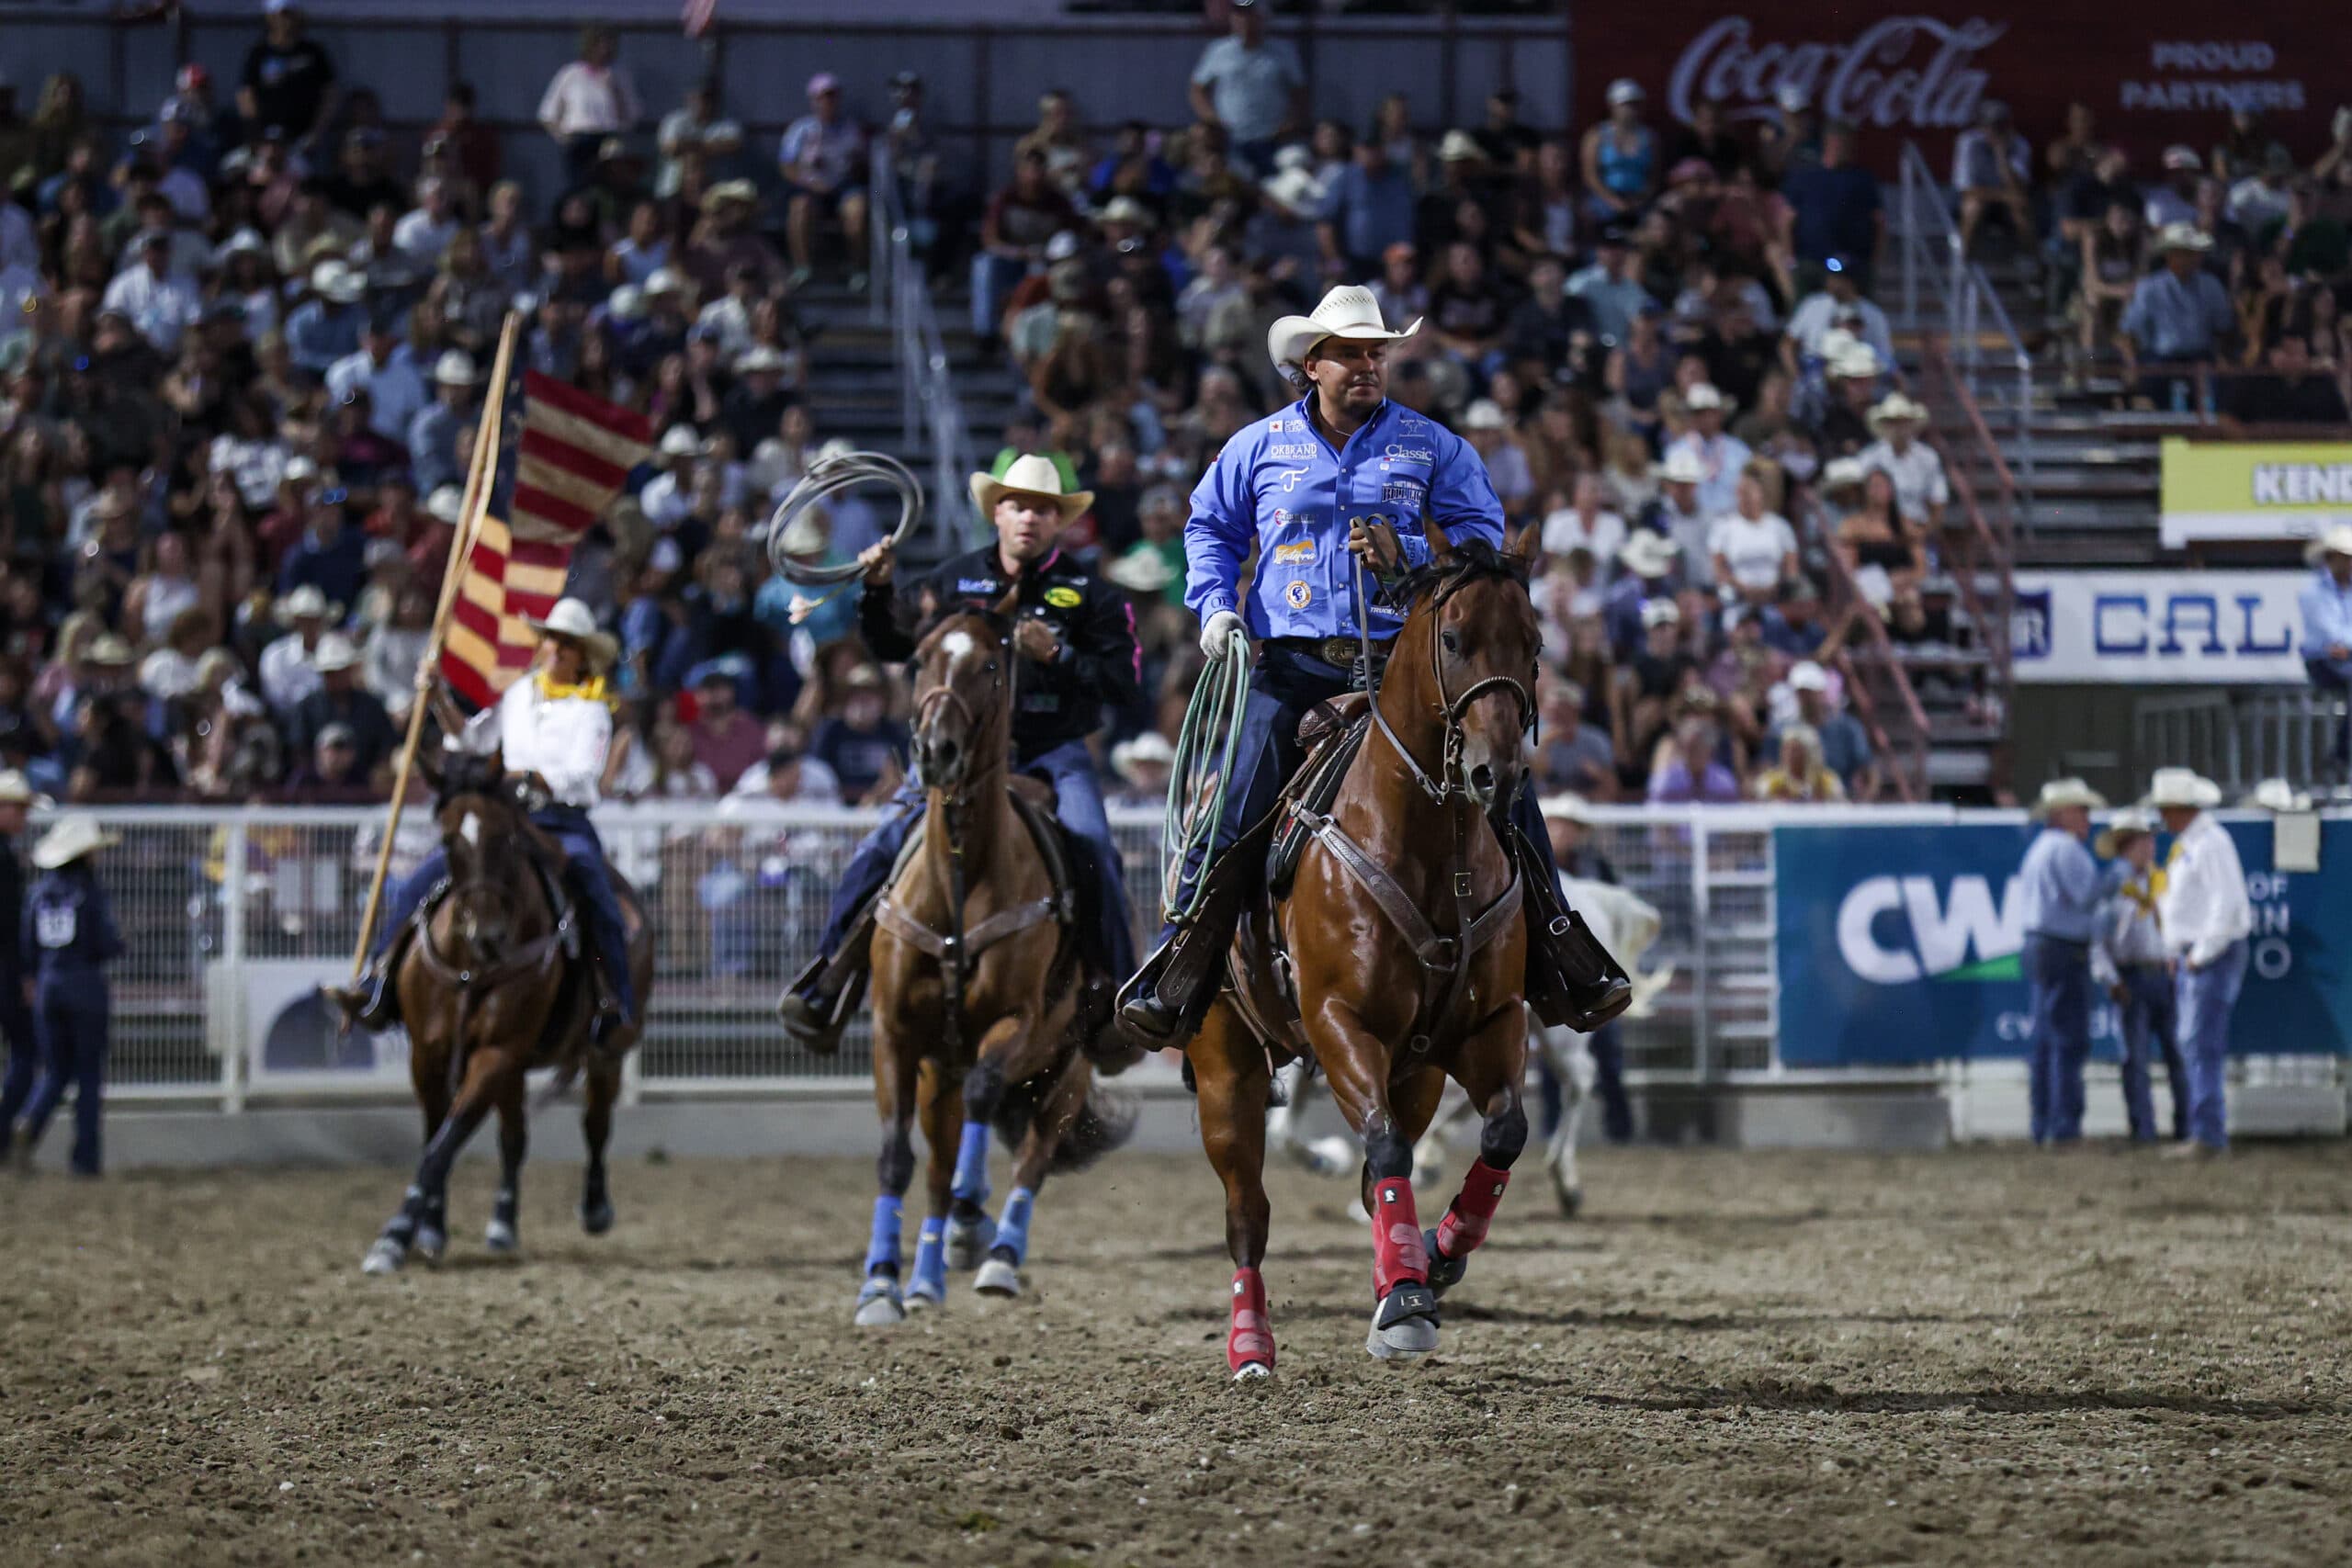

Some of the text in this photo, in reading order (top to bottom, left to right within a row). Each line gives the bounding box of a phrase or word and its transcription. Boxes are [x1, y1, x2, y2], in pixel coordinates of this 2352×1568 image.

[2152, 41, 2275, 71] PROUD
[2120, 81, 2305, 110] PARTNERS
[1385, 444, 1432, 460] Classic
